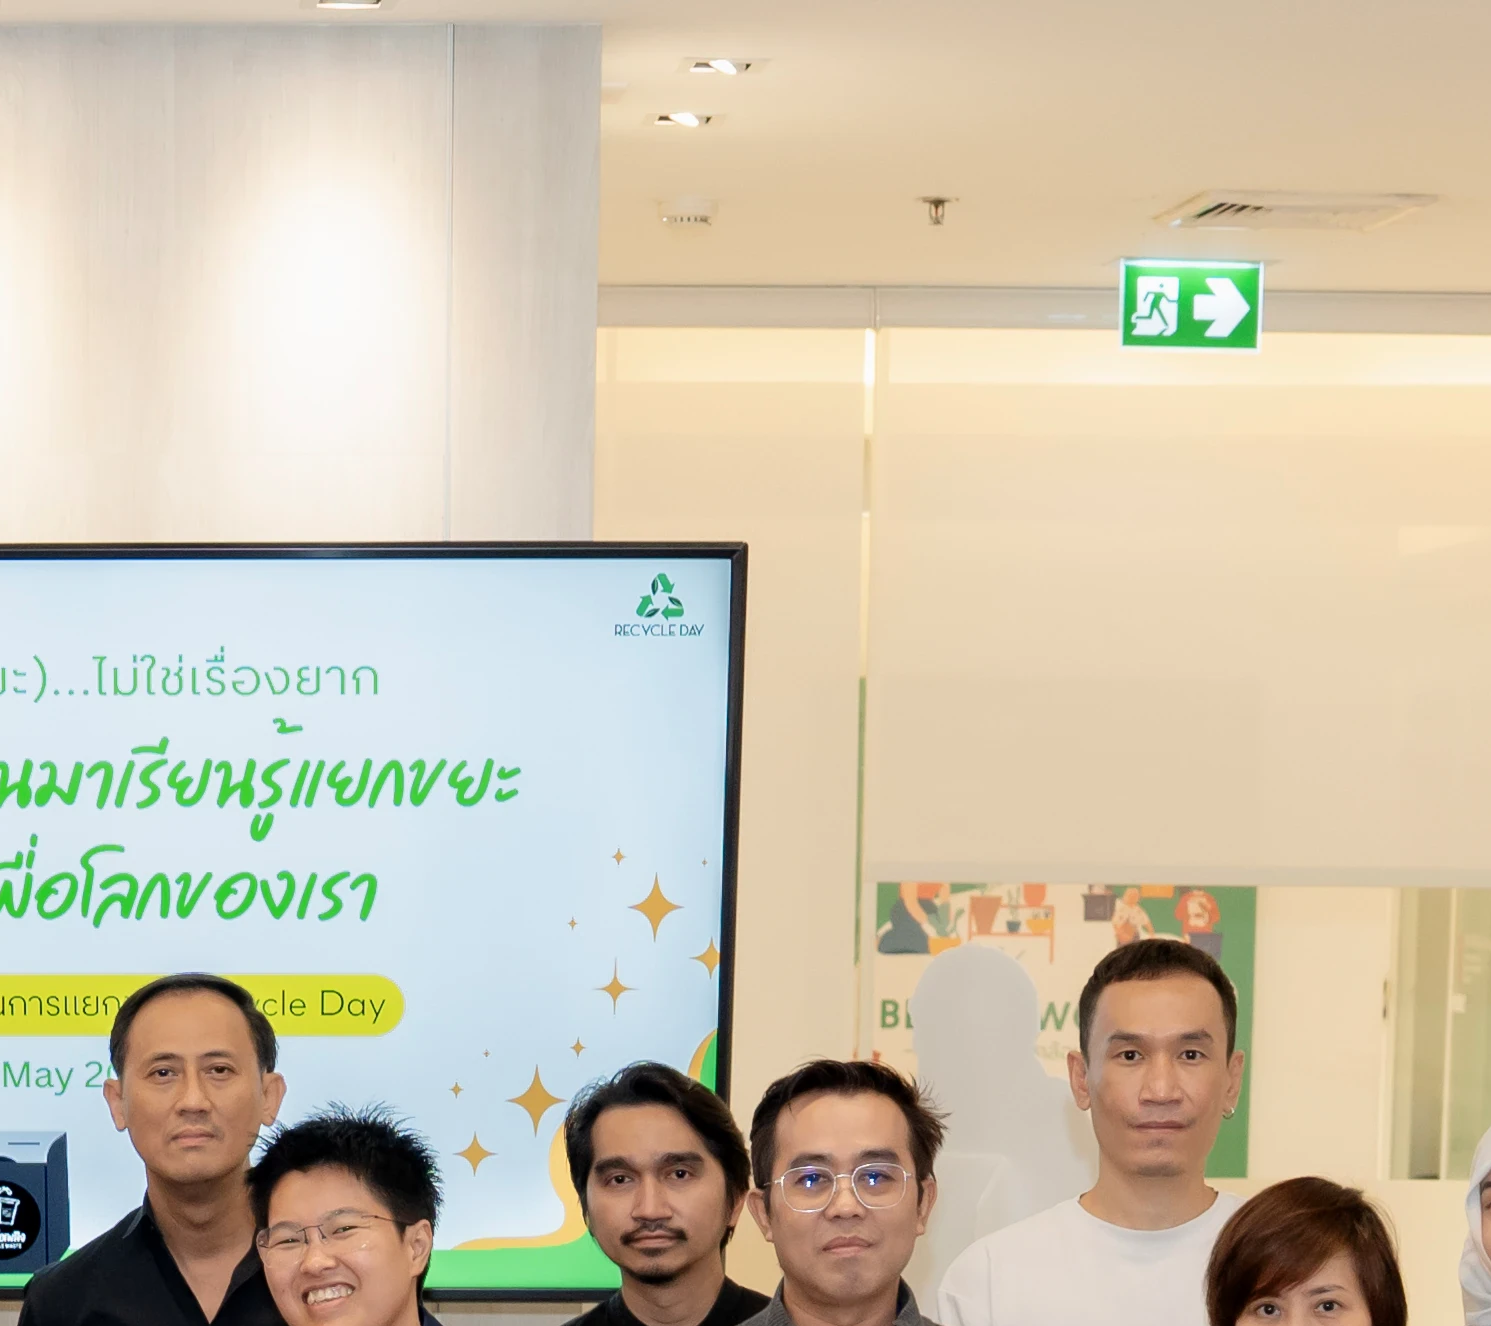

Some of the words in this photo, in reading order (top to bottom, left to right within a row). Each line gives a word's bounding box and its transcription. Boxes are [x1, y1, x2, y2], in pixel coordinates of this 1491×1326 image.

[614, 623, 677, 637] RECYCLE
[679, 623, 705, 637] DAY
[320, 989, 386, 1024] Day
[1, 1061, 73, 1095] May
